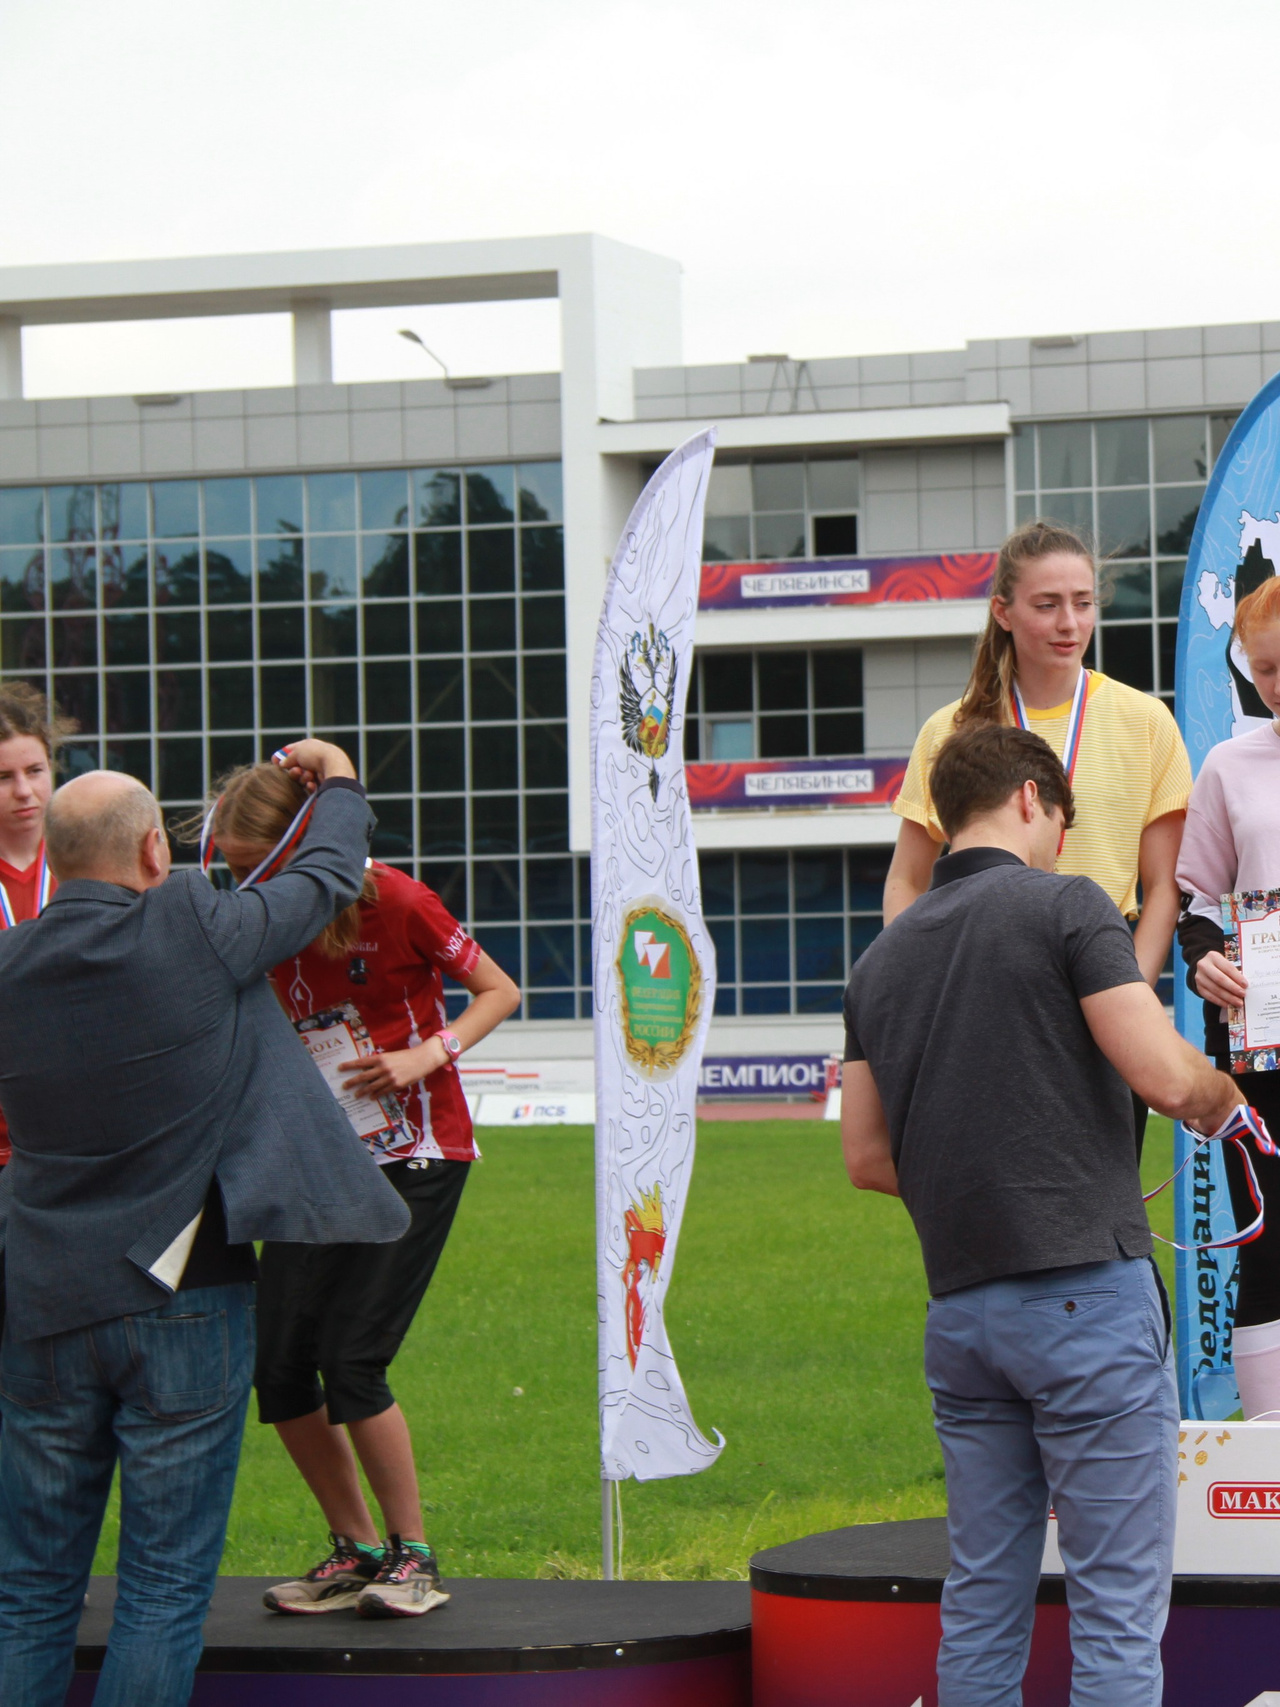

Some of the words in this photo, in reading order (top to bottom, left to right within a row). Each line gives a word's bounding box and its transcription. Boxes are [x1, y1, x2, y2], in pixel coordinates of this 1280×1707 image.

[743, 574, 865, 593] ЧЕЛЯБИНСК
[748, 774, 868, 792] ЧЕЛЯБИНСК
[1193, 1140, 1219, 1377] едераци
